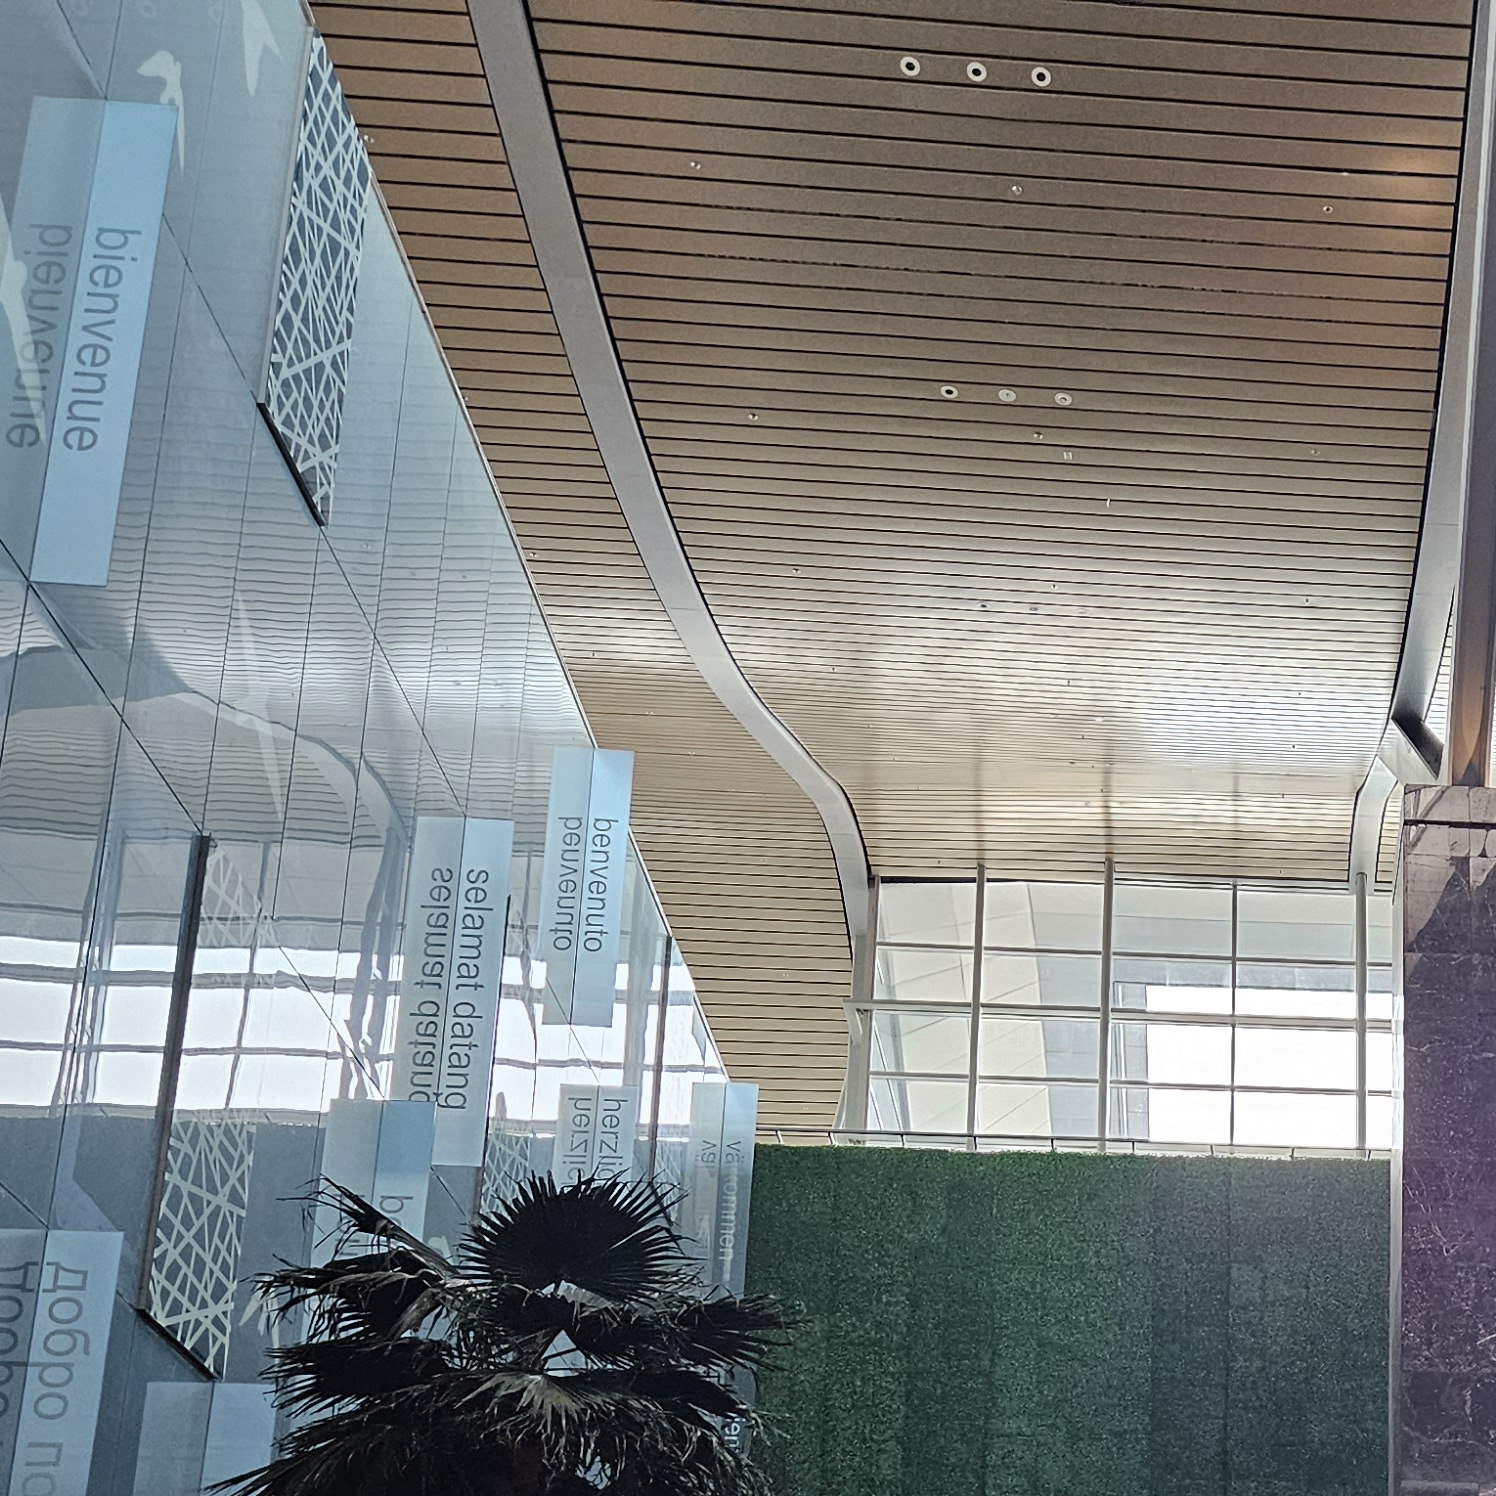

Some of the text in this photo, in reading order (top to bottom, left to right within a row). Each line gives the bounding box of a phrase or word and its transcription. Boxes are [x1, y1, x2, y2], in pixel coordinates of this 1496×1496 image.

[63, 227, 142, 453] bienvenue
[437, 868, 494, 1111] selamat datang
[583, 818, 619, 953] benvenuto
